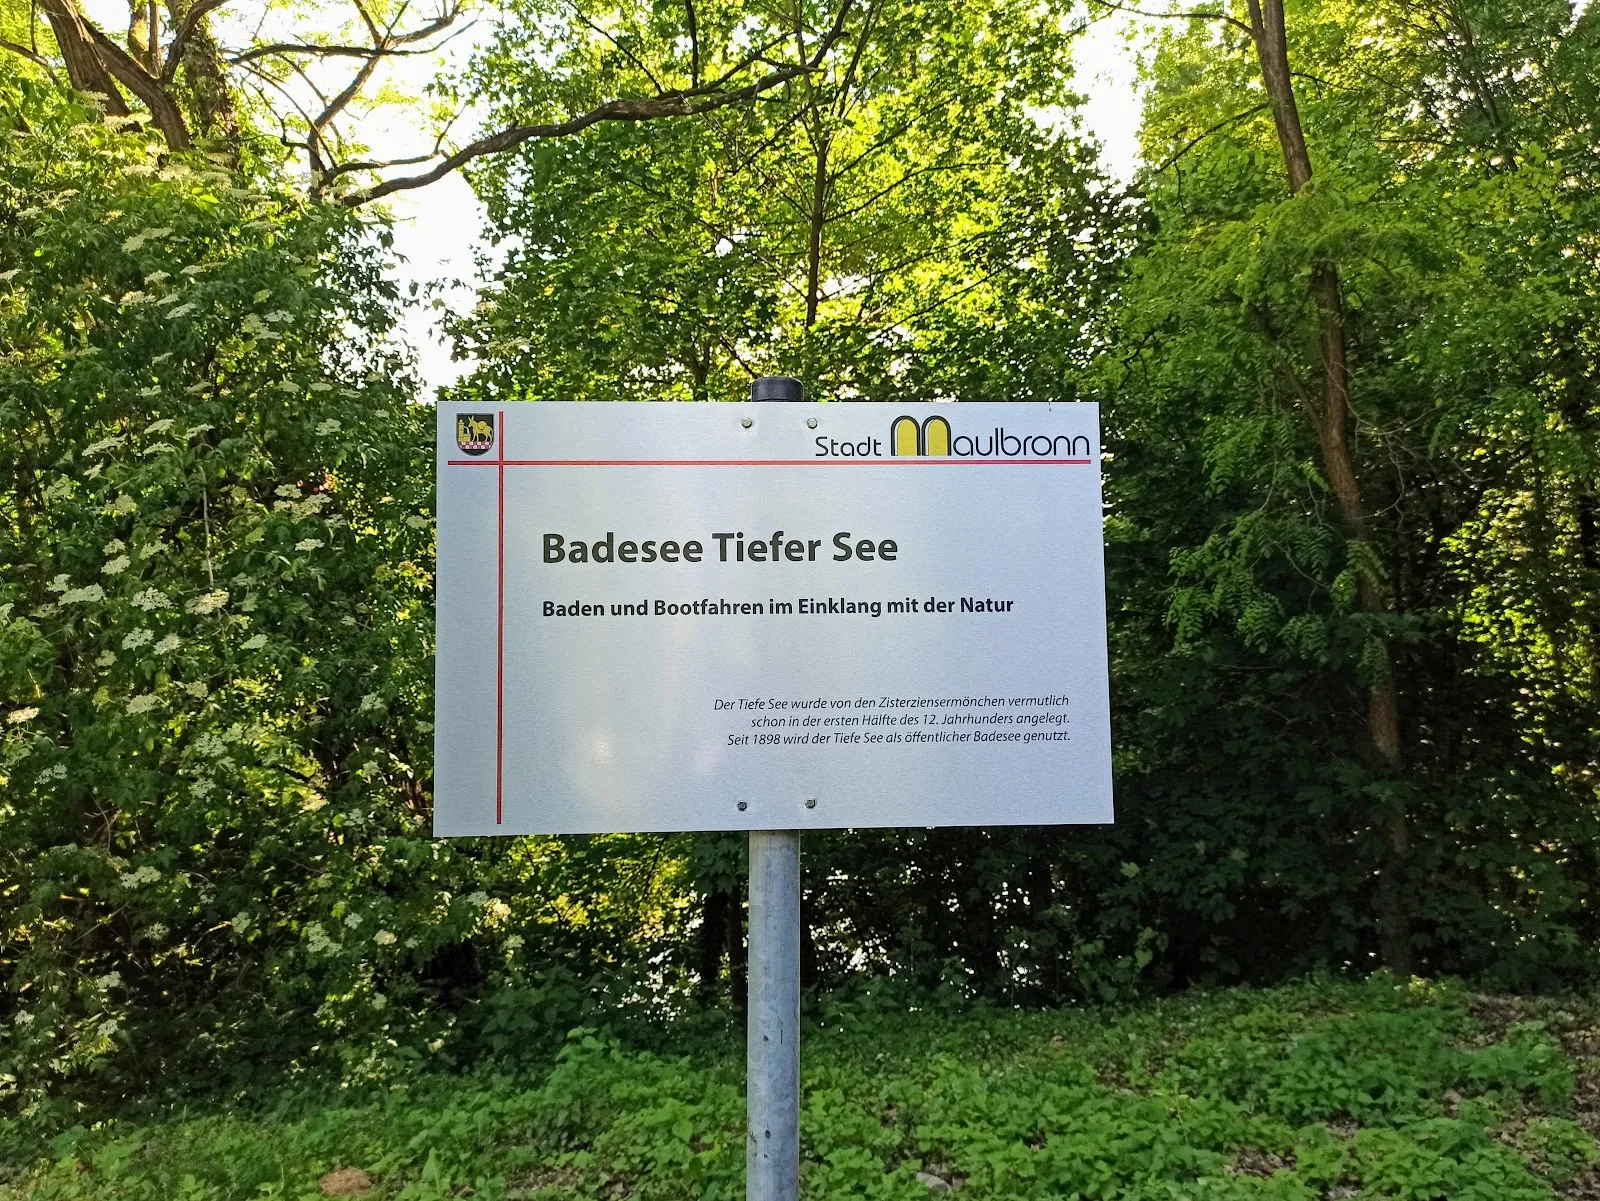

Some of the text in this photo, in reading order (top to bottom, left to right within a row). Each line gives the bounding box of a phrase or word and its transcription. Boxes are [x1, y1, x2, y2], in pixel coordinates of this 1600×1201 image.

[815, 415, 1090, 457] Stadt Maulbronn
[543, 531, 898, 563] Badesee Tiefer See
[543, 597, 1014, 618] Baden und Bootfahren im Einklang mit der Natur
[714, 695, 1069, 711] Der Tiefe See wurde von den Zisterziensermönchen vermutlich
[751, 712, 1070, 728] schon in der ersten Hälfte des 12. Jahrhunders angelegt.
[728, 730, 1071, 746] Seit 1898 wird der Tiefe See als öffentlicher Badesee genutzt.
